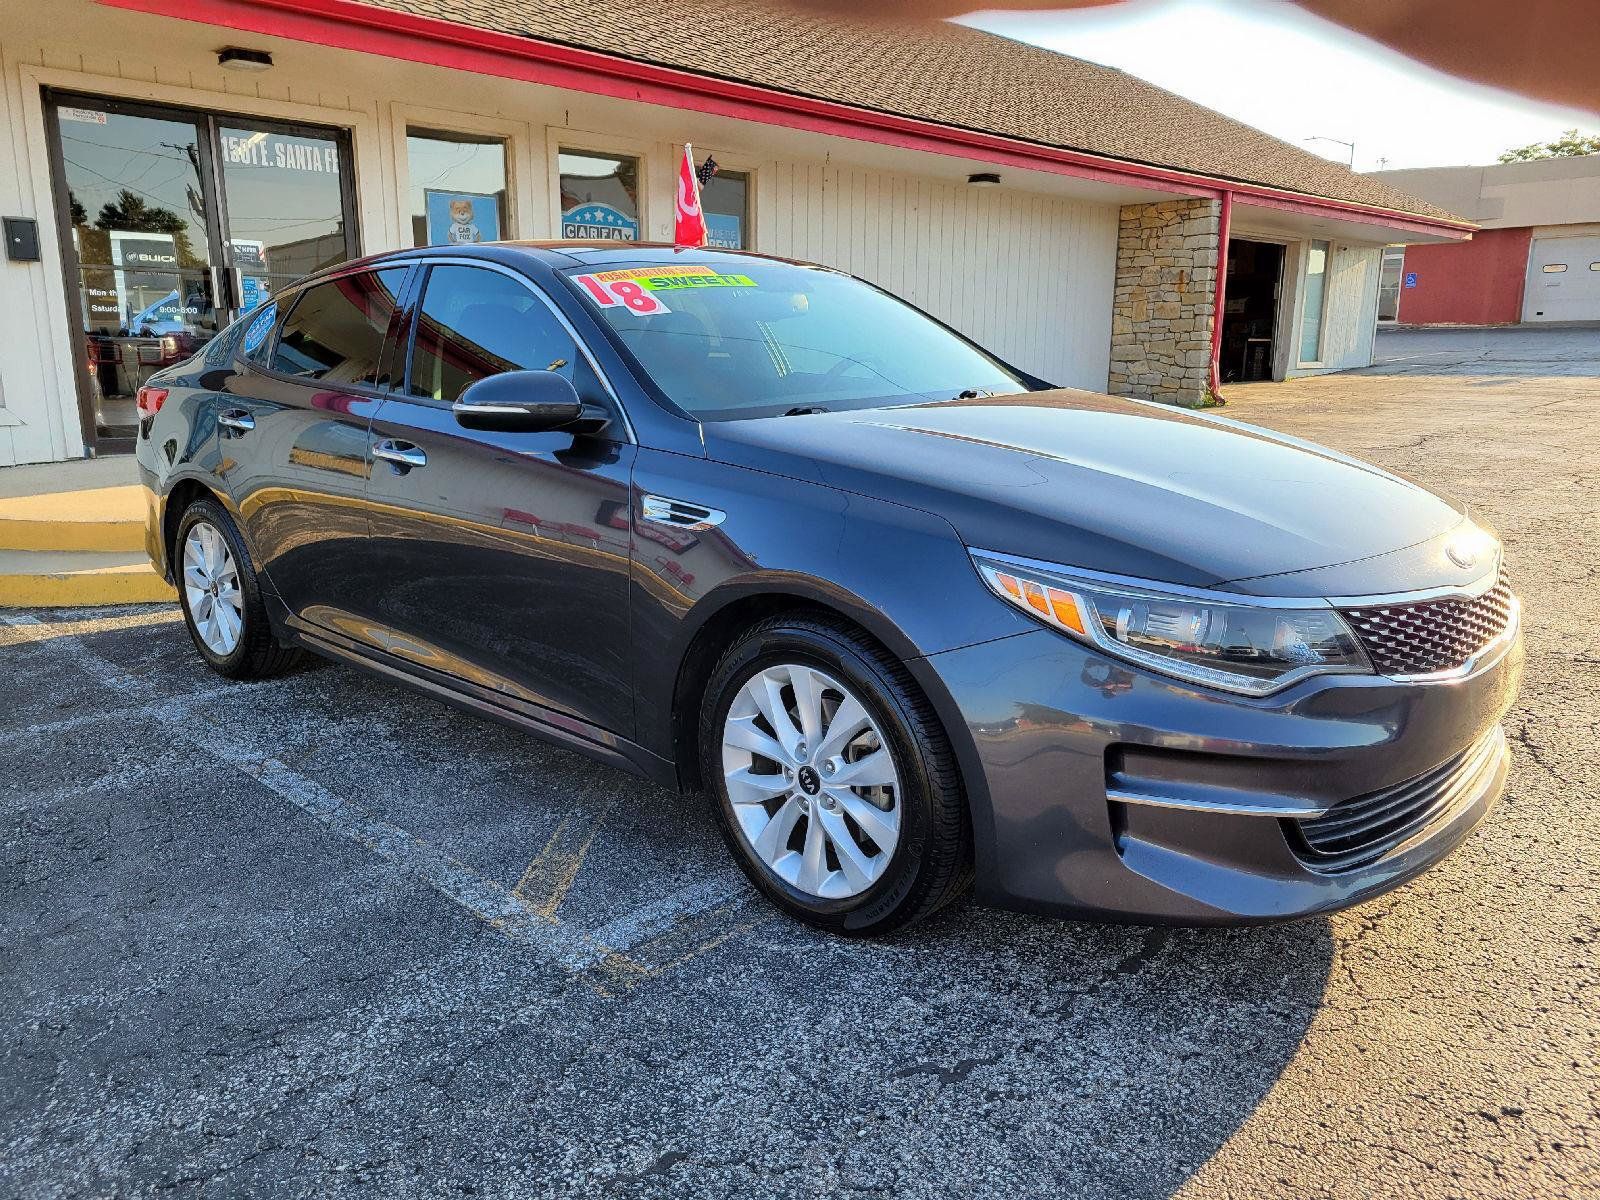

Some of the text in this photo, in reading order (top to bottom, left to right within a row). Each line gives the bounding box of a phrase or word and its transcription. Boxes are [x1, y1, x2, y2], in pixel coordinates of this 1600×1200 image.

[274, 142, 323, 172] SANTA
[324, 147, 340, 173] FE
[457, 226, 471, 234] CAR
[139, 253, 176, 263] BUICK
[597, 270, 630, 283] PUSH
[631, 267, 675, 278] BUTTON
[89, 288, 107, 297] Mon
[577, 276, 658, 313] 18
[91, 304, 121, 313] Saturda
[800, 768, 815, 794] KIA
